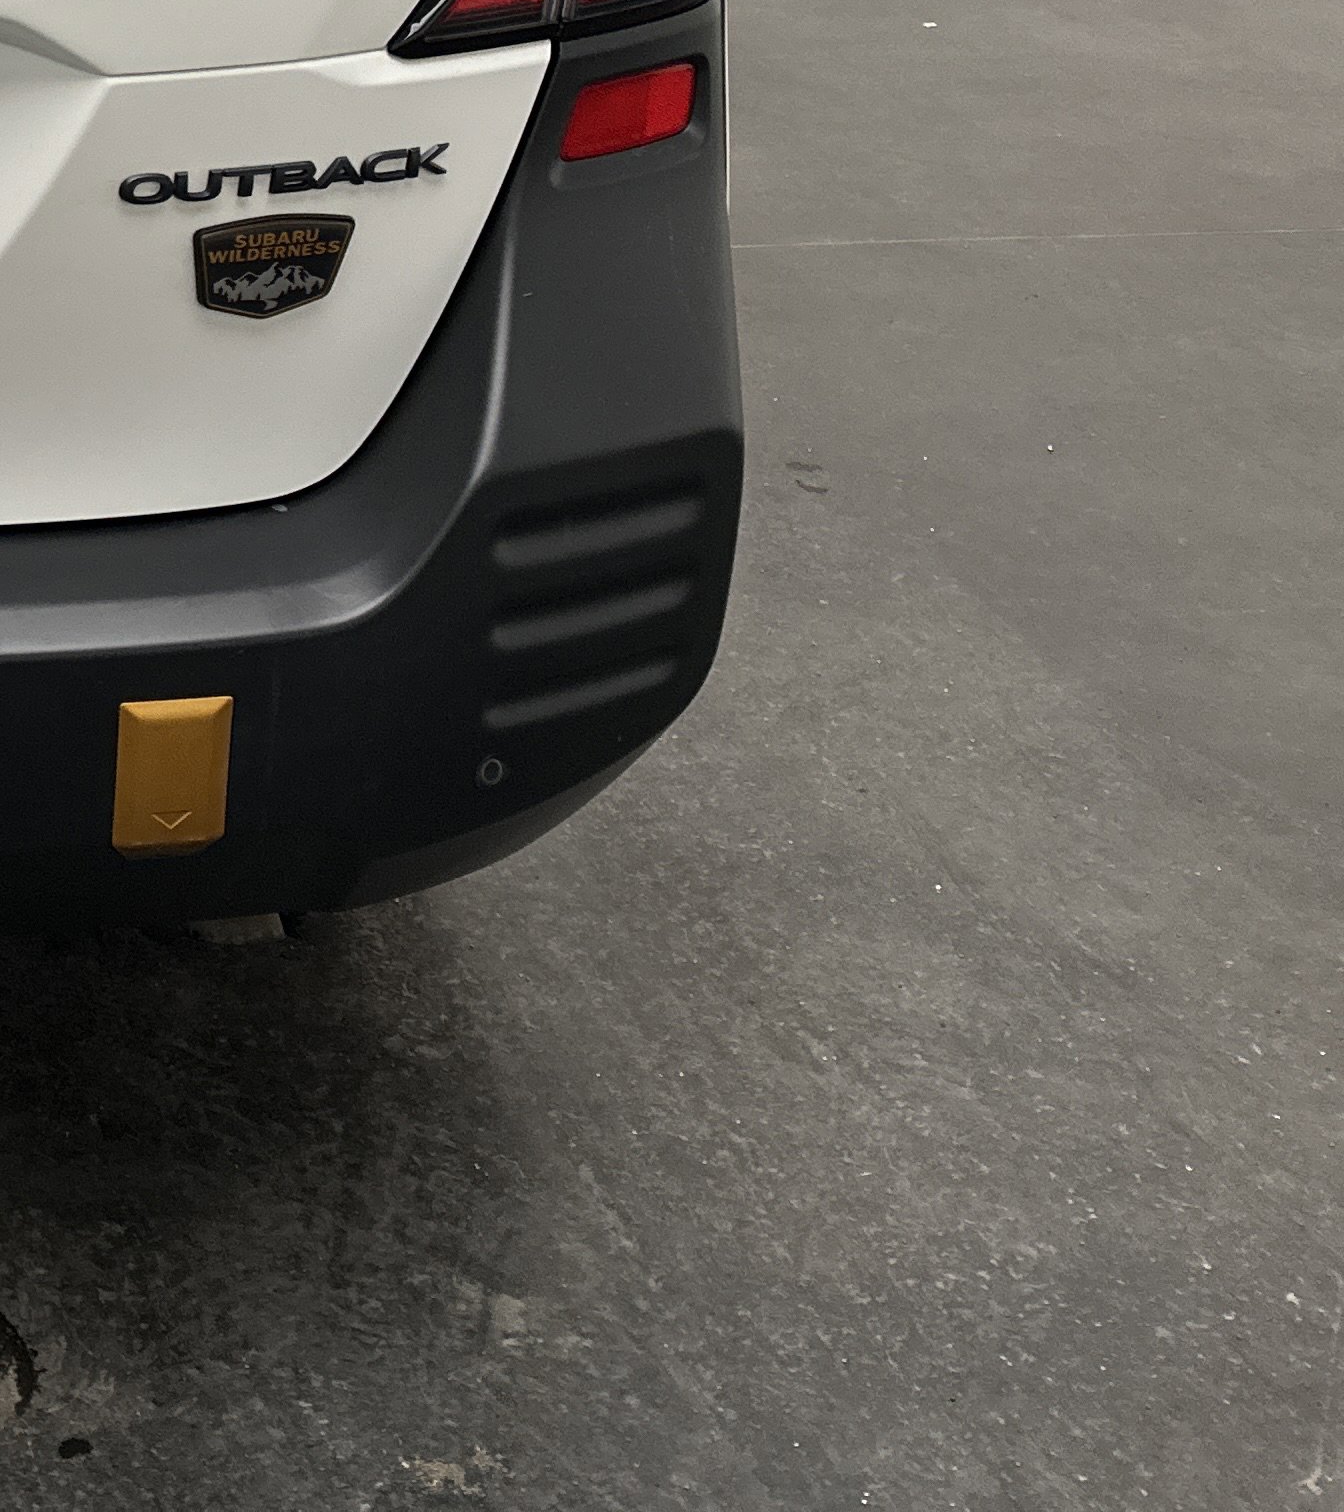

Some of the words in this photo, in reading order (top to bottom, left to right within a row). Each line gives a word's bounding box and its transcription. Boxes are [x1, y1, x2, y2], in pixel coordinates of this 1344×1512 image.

[118, 142, 450, 205] OUTBACK
[233, 228, 320, 248] SUBARU
[208, 240, 342, 264] WILDERNESS
